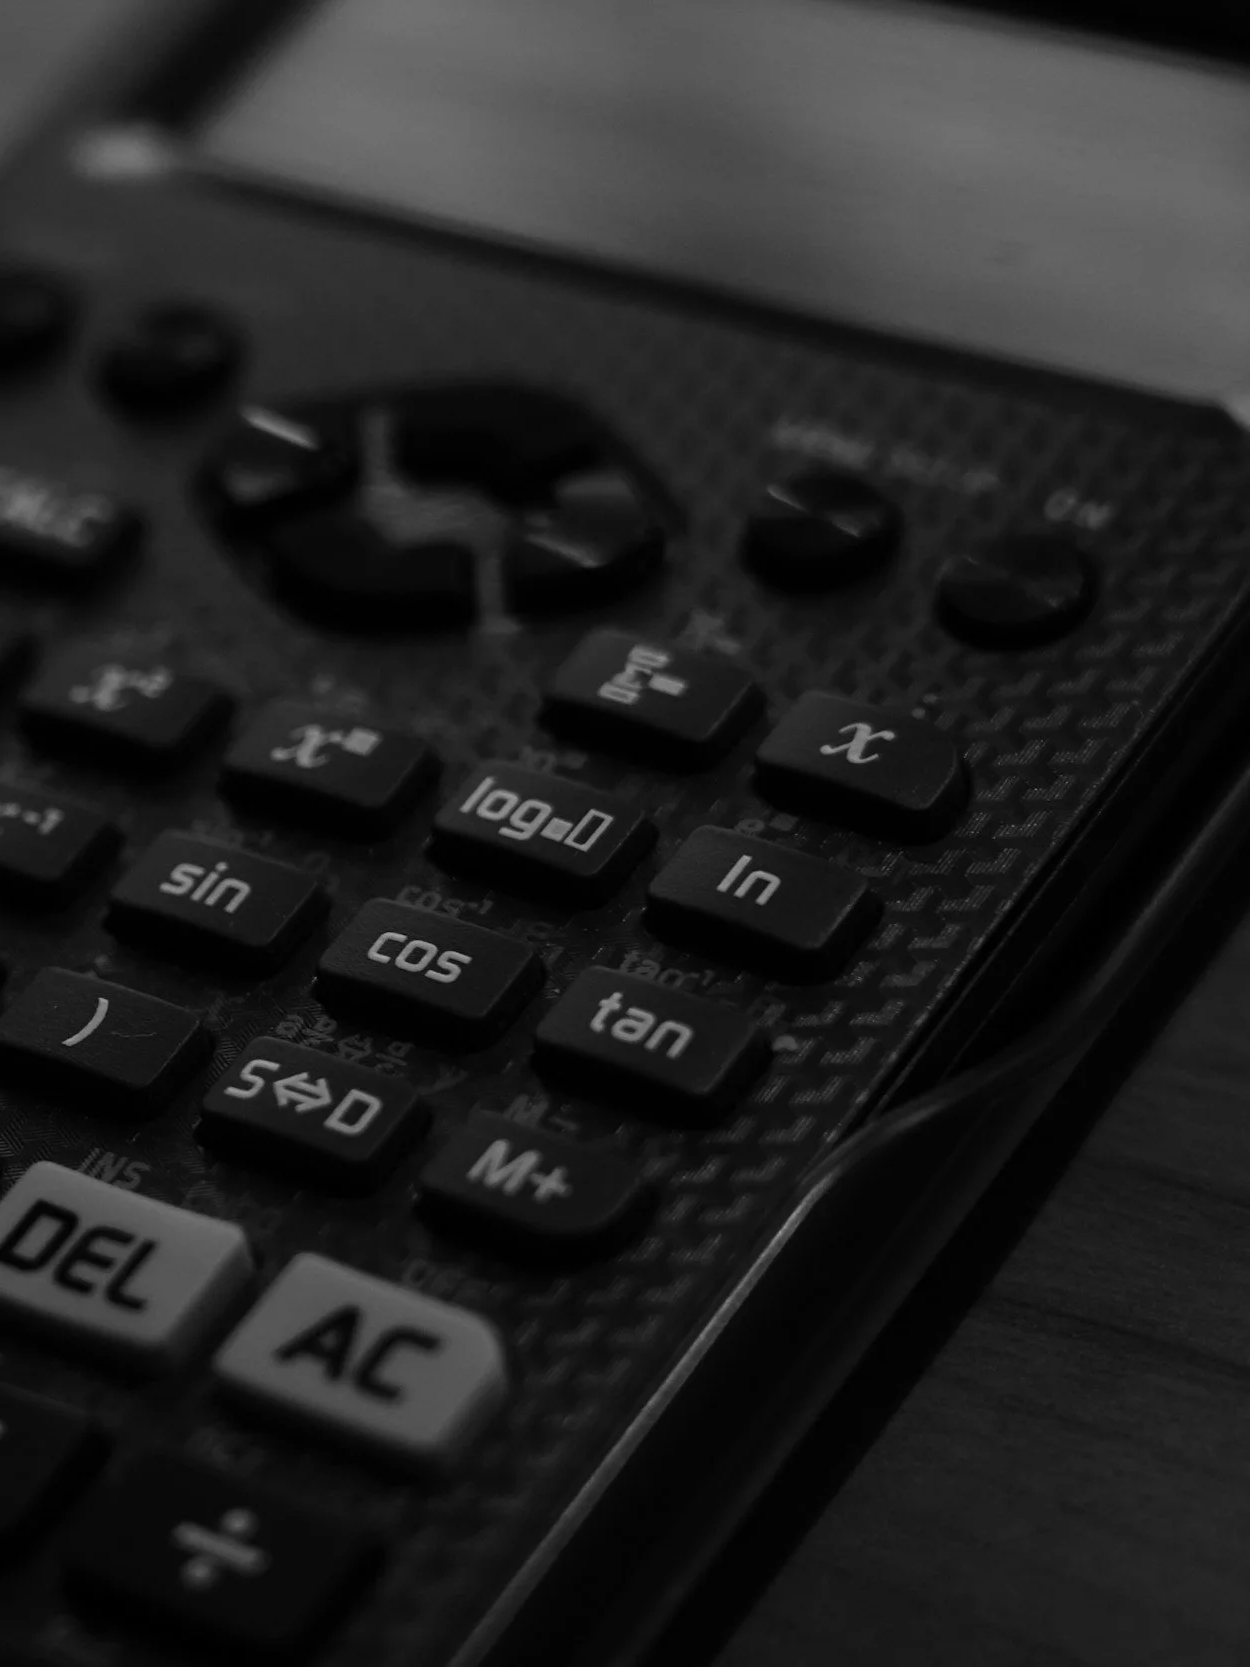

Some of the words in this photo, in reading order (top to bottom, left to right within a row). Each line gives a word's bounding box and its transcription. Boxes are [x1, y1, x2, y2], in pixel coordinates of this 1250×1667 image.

[818, 722, 897, 765] x
[159, 861, 251, 914] sin
[716, 854, 781, 906] ln
[367, 931, 473, 983] cos
[590, 990, 695, 1059] tan
[77, 1147, 151, 1190] INS
[466, 1138, 572, 1204] M+
[277, 1306, 446, 1400] AC
